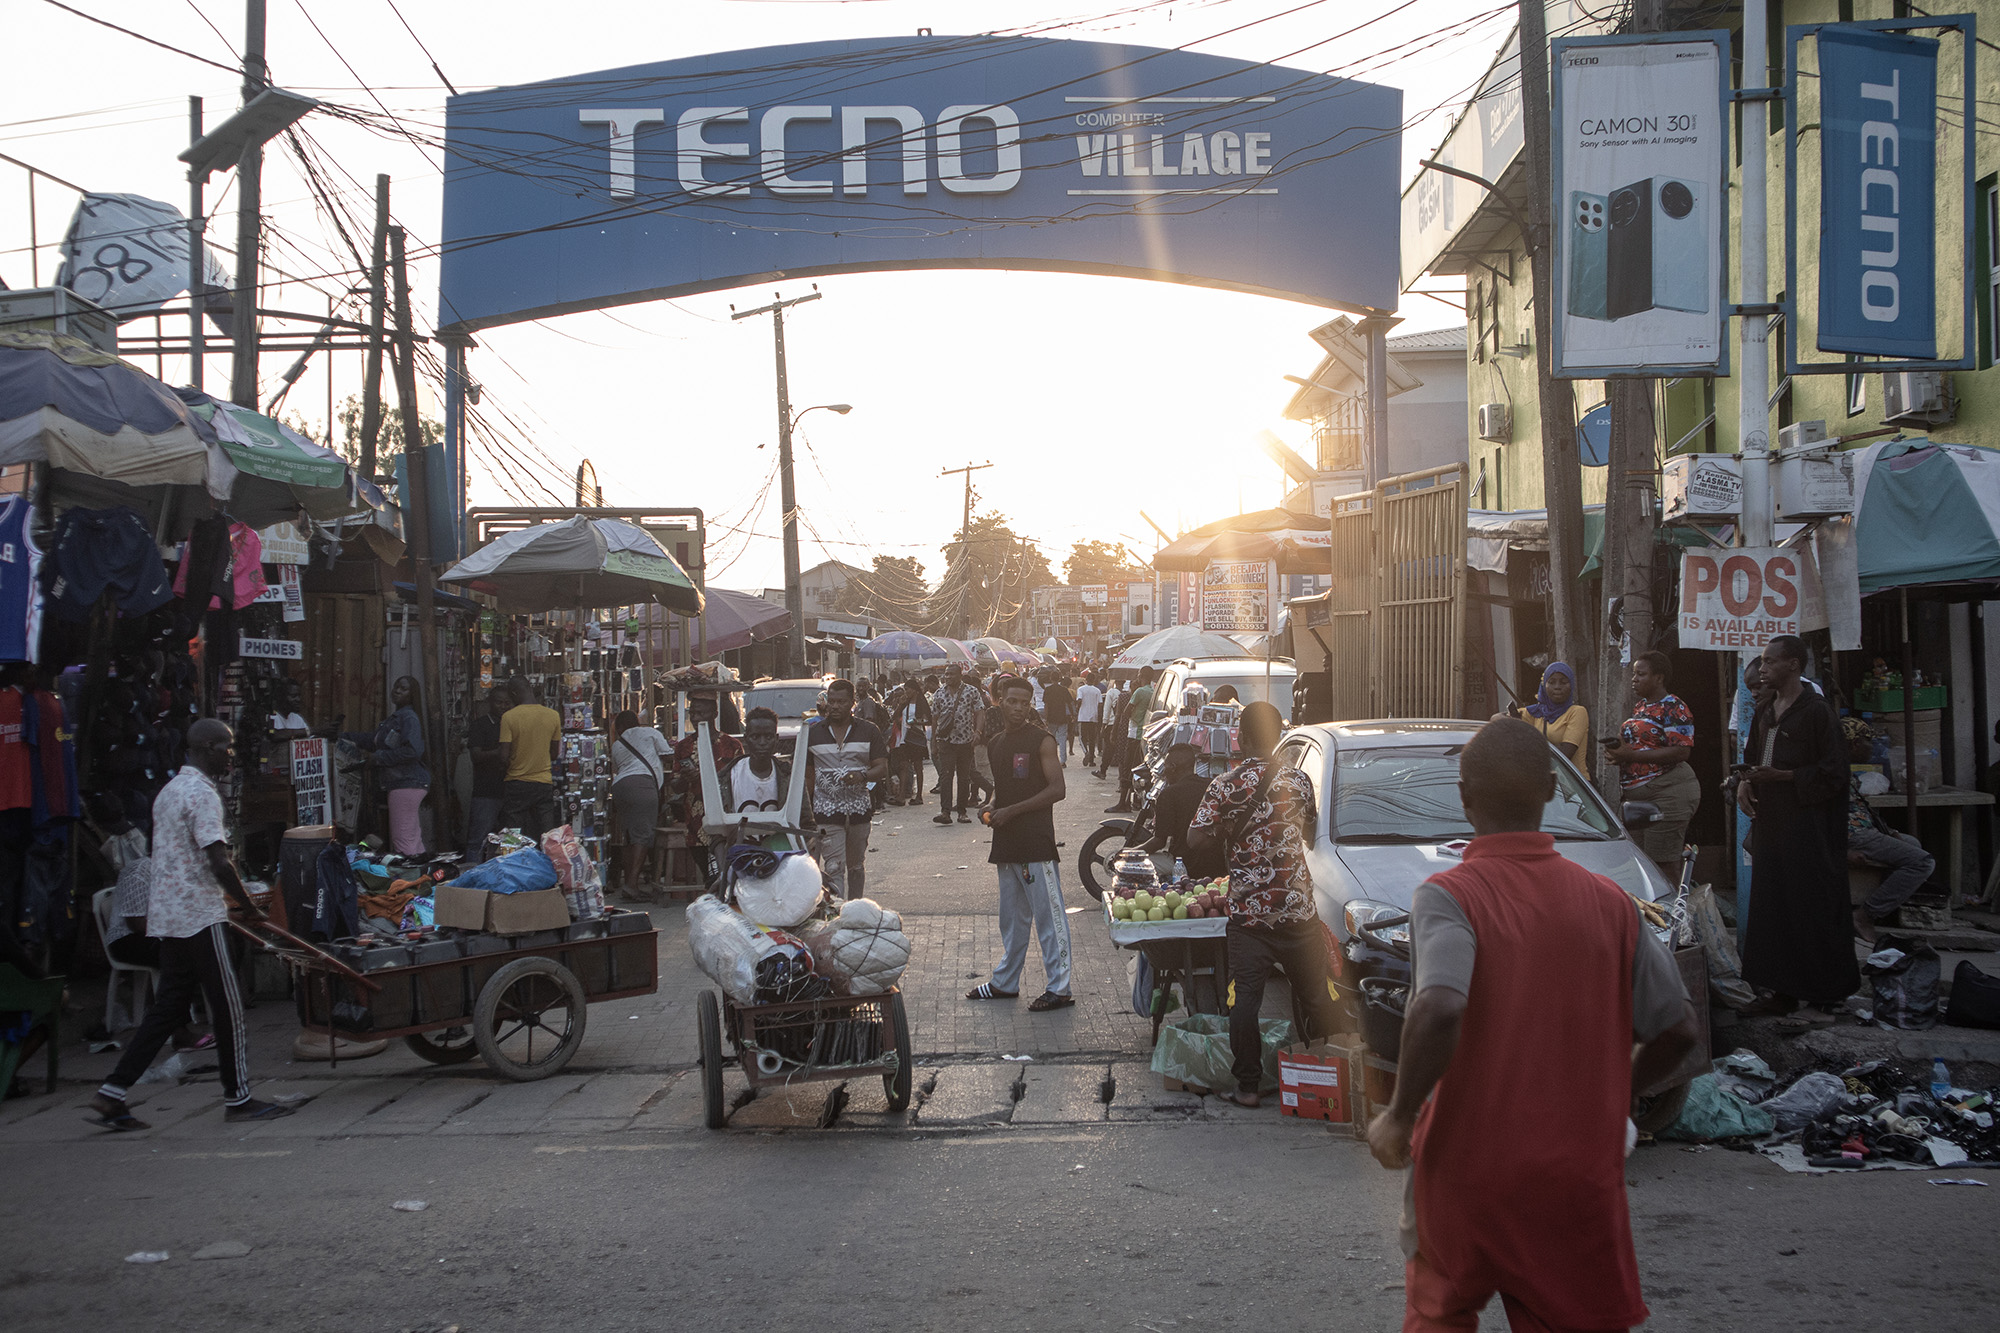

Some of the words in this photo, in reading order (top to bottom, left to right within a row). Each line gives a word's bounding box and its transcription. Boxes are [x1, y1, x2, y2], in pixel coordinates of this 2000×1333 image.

[1568, 57, 1599, 66] TECNO
[1075, 112, 1165, 126] COMPUTER
[1580, 117, 1658, 135] CAMON
[1667, 115, 1690, 131] 30
[1580, 140, 1599, 148] Sony
[1632, 137, 1648, 145] with
[1663, 135, 1697, 144] Imaging
[579, 104, 1021, 199] TECNO
[1076, 131, 1272, 176] VILLAGE
[1429, 185, 1440, 223] SIM
[1860, 69, 1899, 322] TECNO
[247, 452, 276, 463] QUALITY
[281, 460, 309, 470] FASTEST
[310, 463, 332, 474] SPEED
[254, 463, 270, 472] BEST
[270, 467, 293, 478] VALUE
[1696, 474, 1728, 488] PLASMA
[1705, 471, 1734, 481] Rentals
[269, 552, 298, 564] HERE
[1230, 564, 1262, 573] BEEJAY
[1230, 573, 1265, 583] CONNECT
[1683, 555, 1798, 618] POS
[51, 575, 66, 599] NIKE
[1683, 617, 1700, 629] IS
[1705, 619, 1796, 634] AVAILABLE
[245, 641, 296, 656] PHONES
[1710, 633, 1770, 647] HERE
[295, 738, 323, 759] REPAIR
[296, 759, 322, 777] FLASH
[295, 775, 325, 792] UNLOCK
[316, 888, 324, 919] adidas
